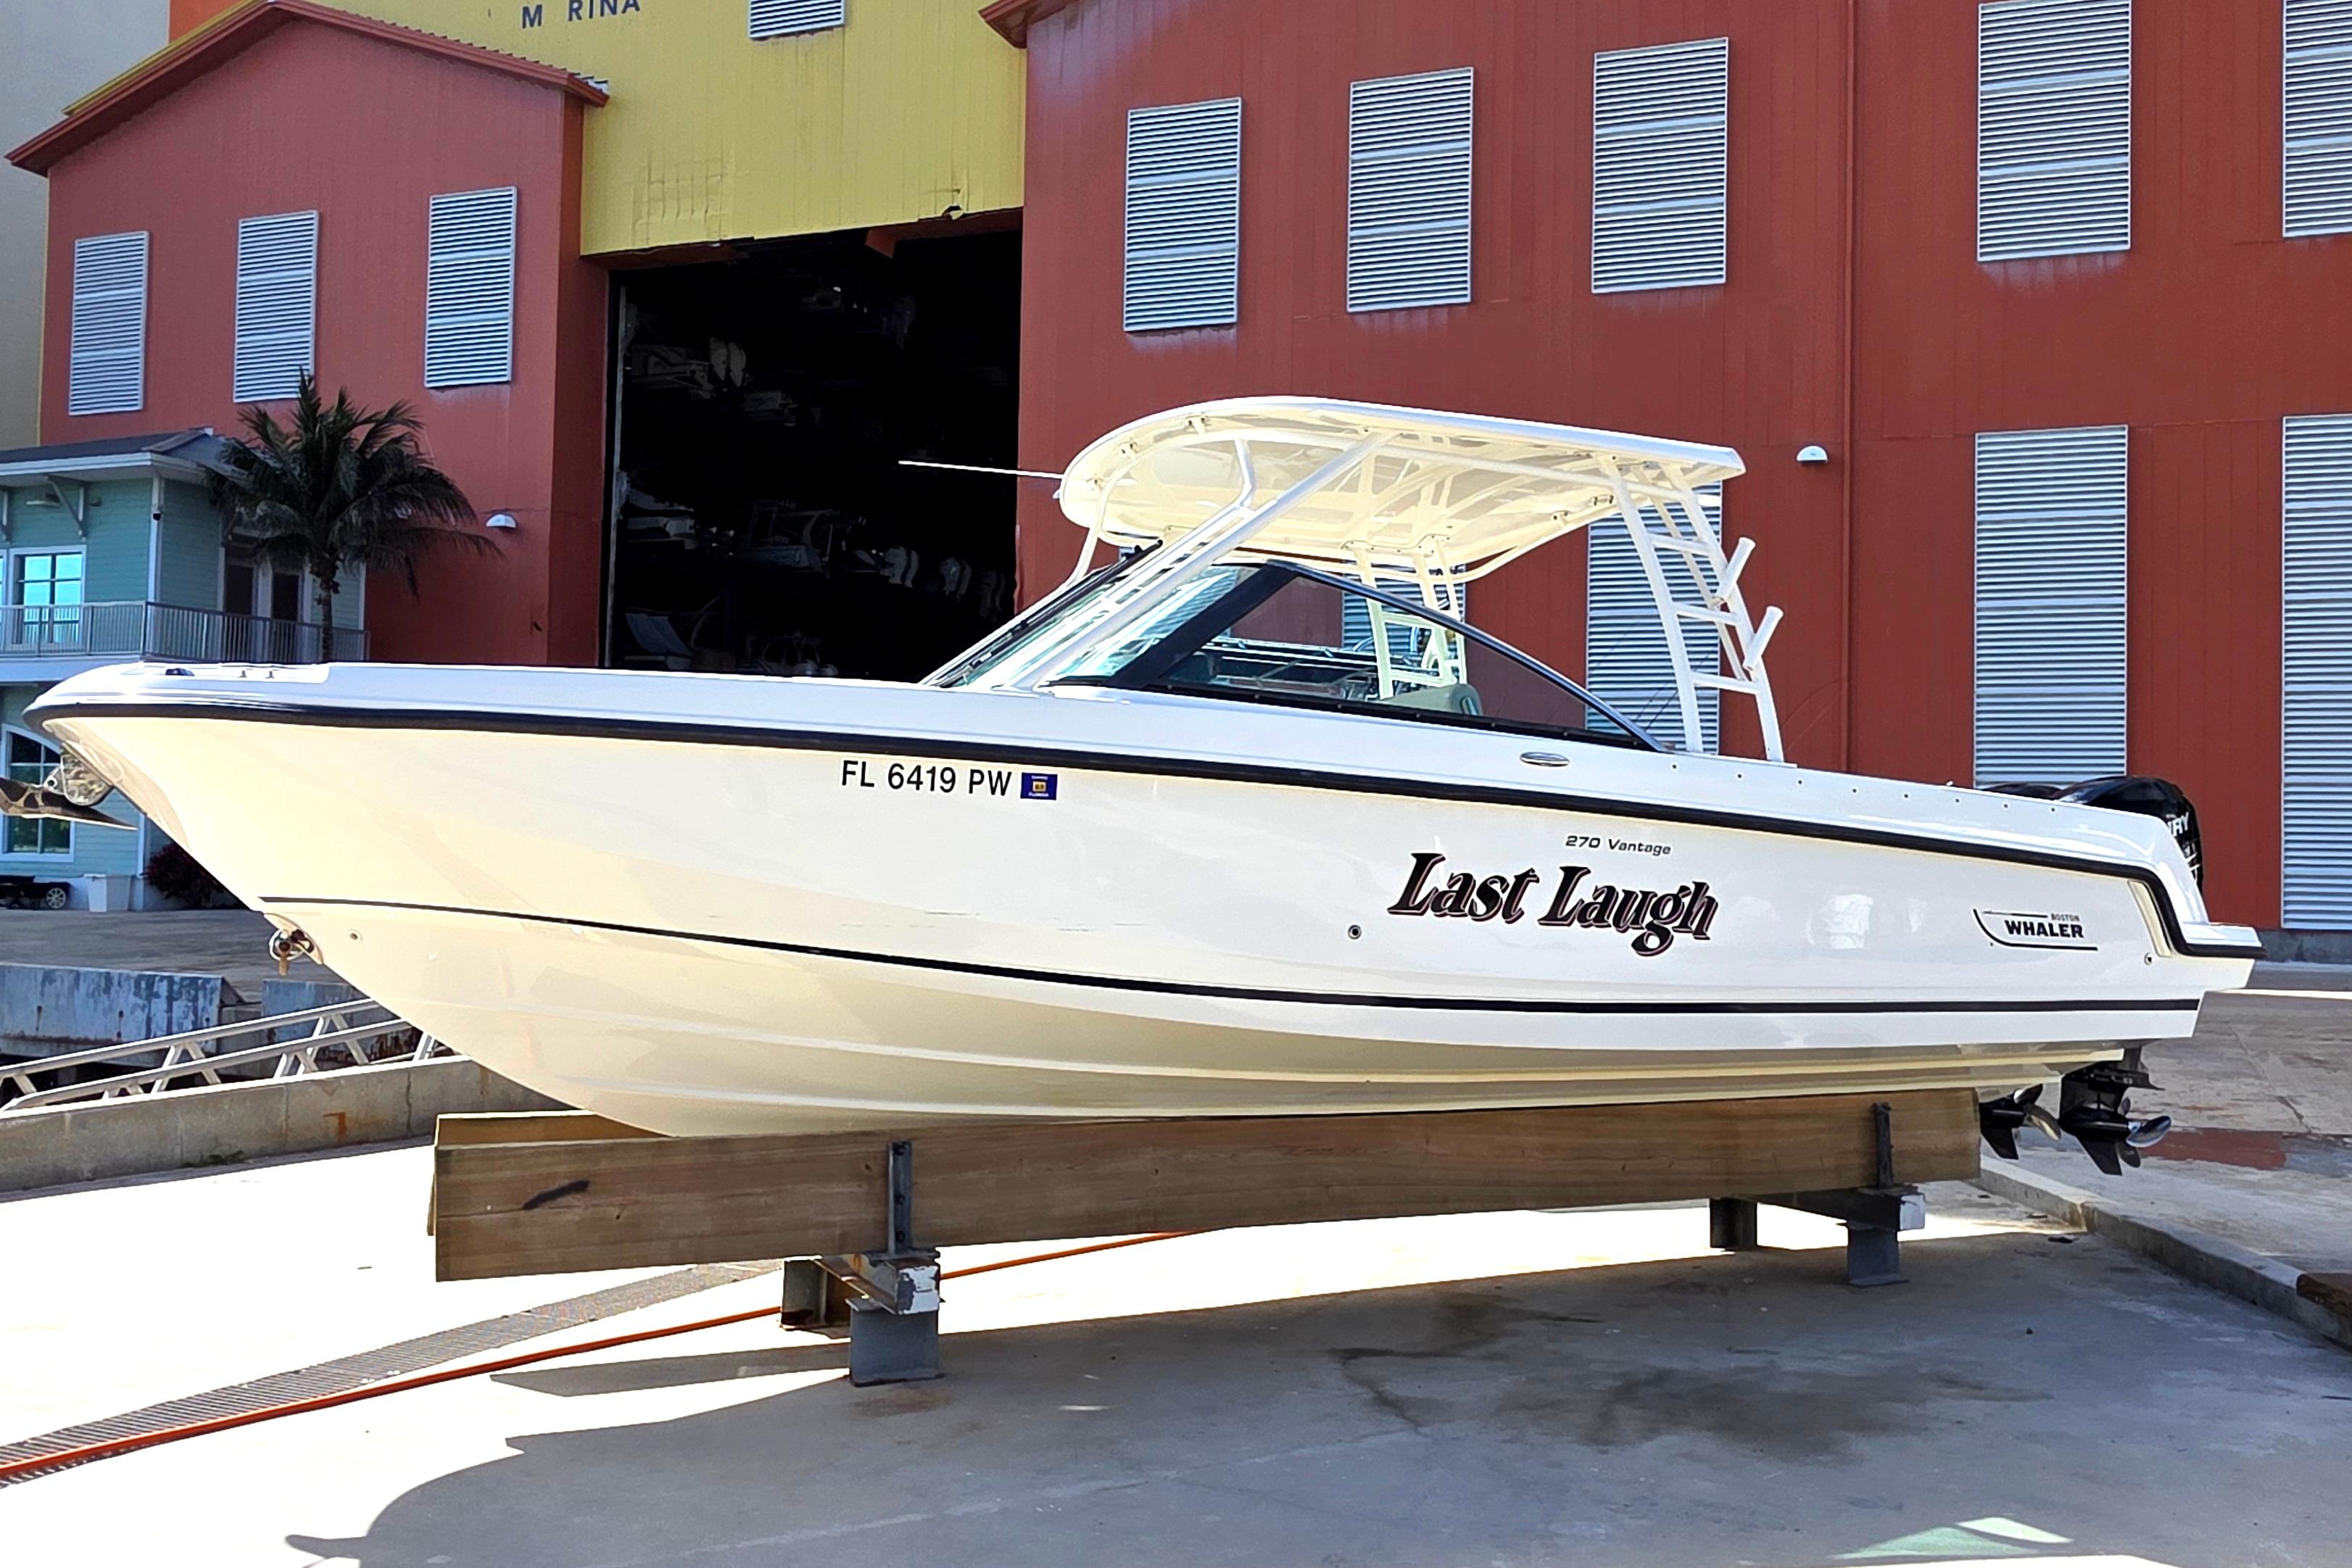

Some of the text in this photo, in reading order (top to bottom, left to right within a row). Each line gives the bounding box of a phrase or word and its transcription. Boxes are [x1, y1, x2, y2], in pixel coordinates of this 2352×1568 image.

[842, 760, 1012, 796] FL 6419 PW
[1565, 835, 1671, 857] 270 Vantage
[1387, 853, 1719, 957] Last Laugh
[2050, 913, 2080, 922] BOSTON
[2004, 920, 2084, 939] WHALER
